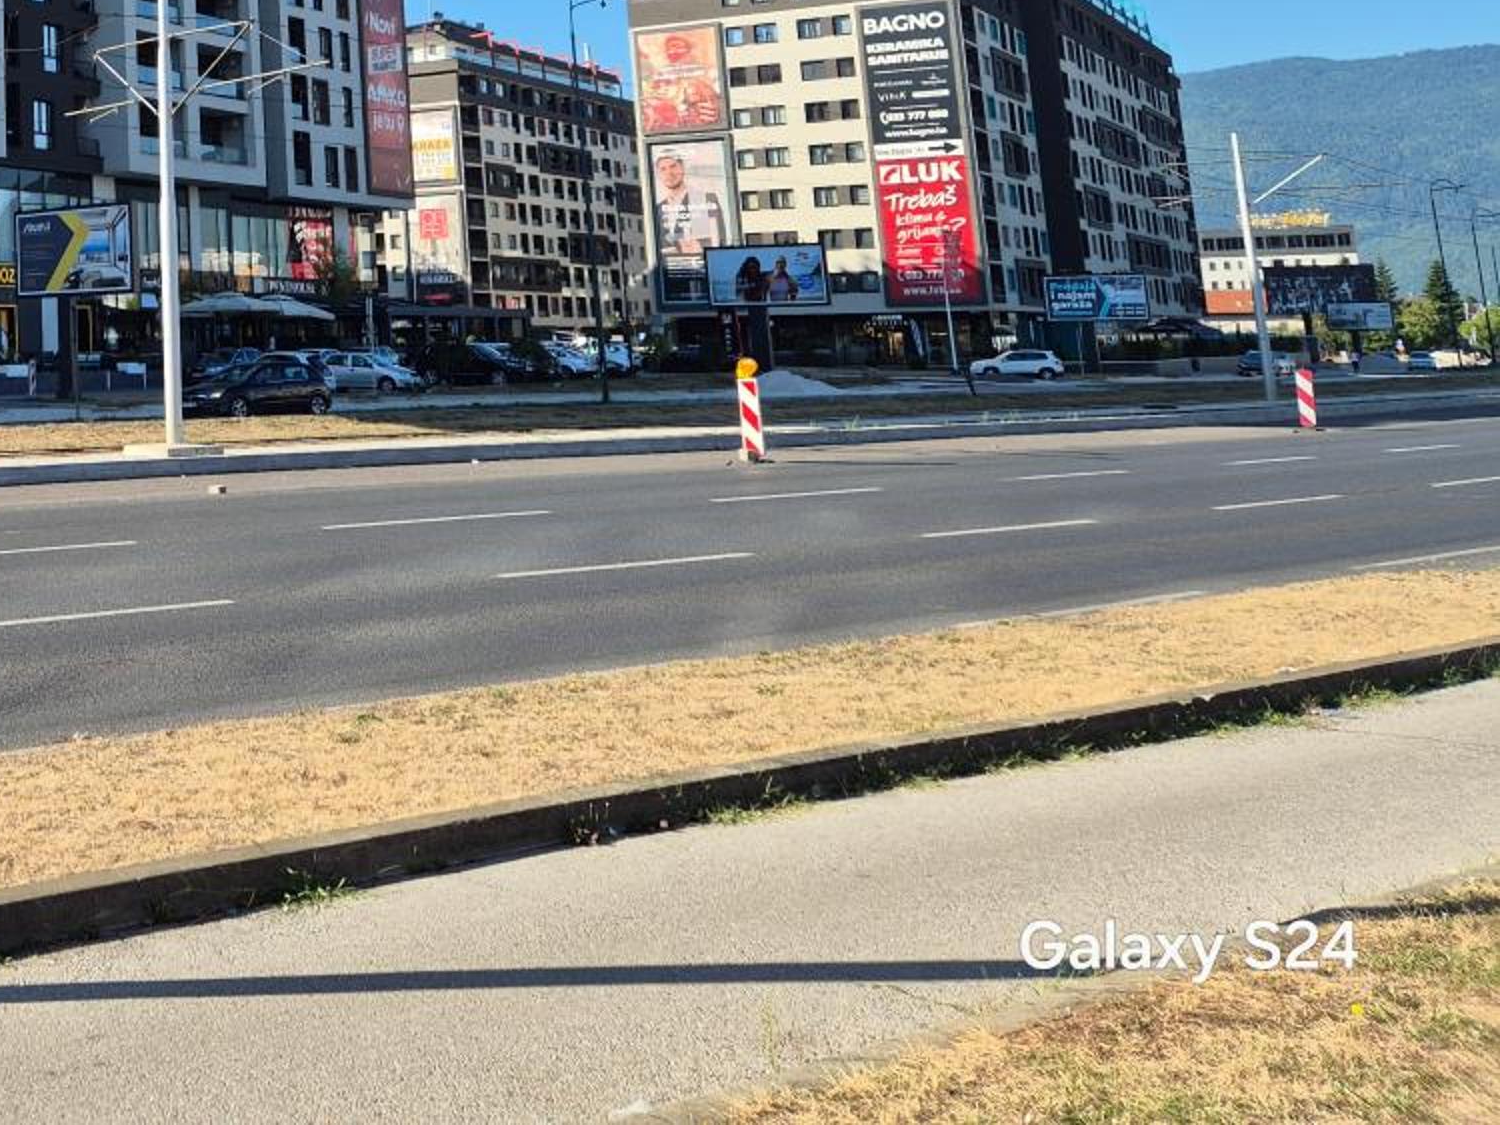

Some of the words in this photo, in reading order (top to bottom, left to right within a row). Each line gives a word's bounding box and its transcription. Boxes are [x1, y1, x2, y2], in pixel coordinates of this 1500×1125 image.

[863, 11, 945, 35] BAGNO
[866, 37, 944, 54] KERAMIKA
[902, 161, 963, 184] LUK
[883, 184, 957, 212] Trebaš
